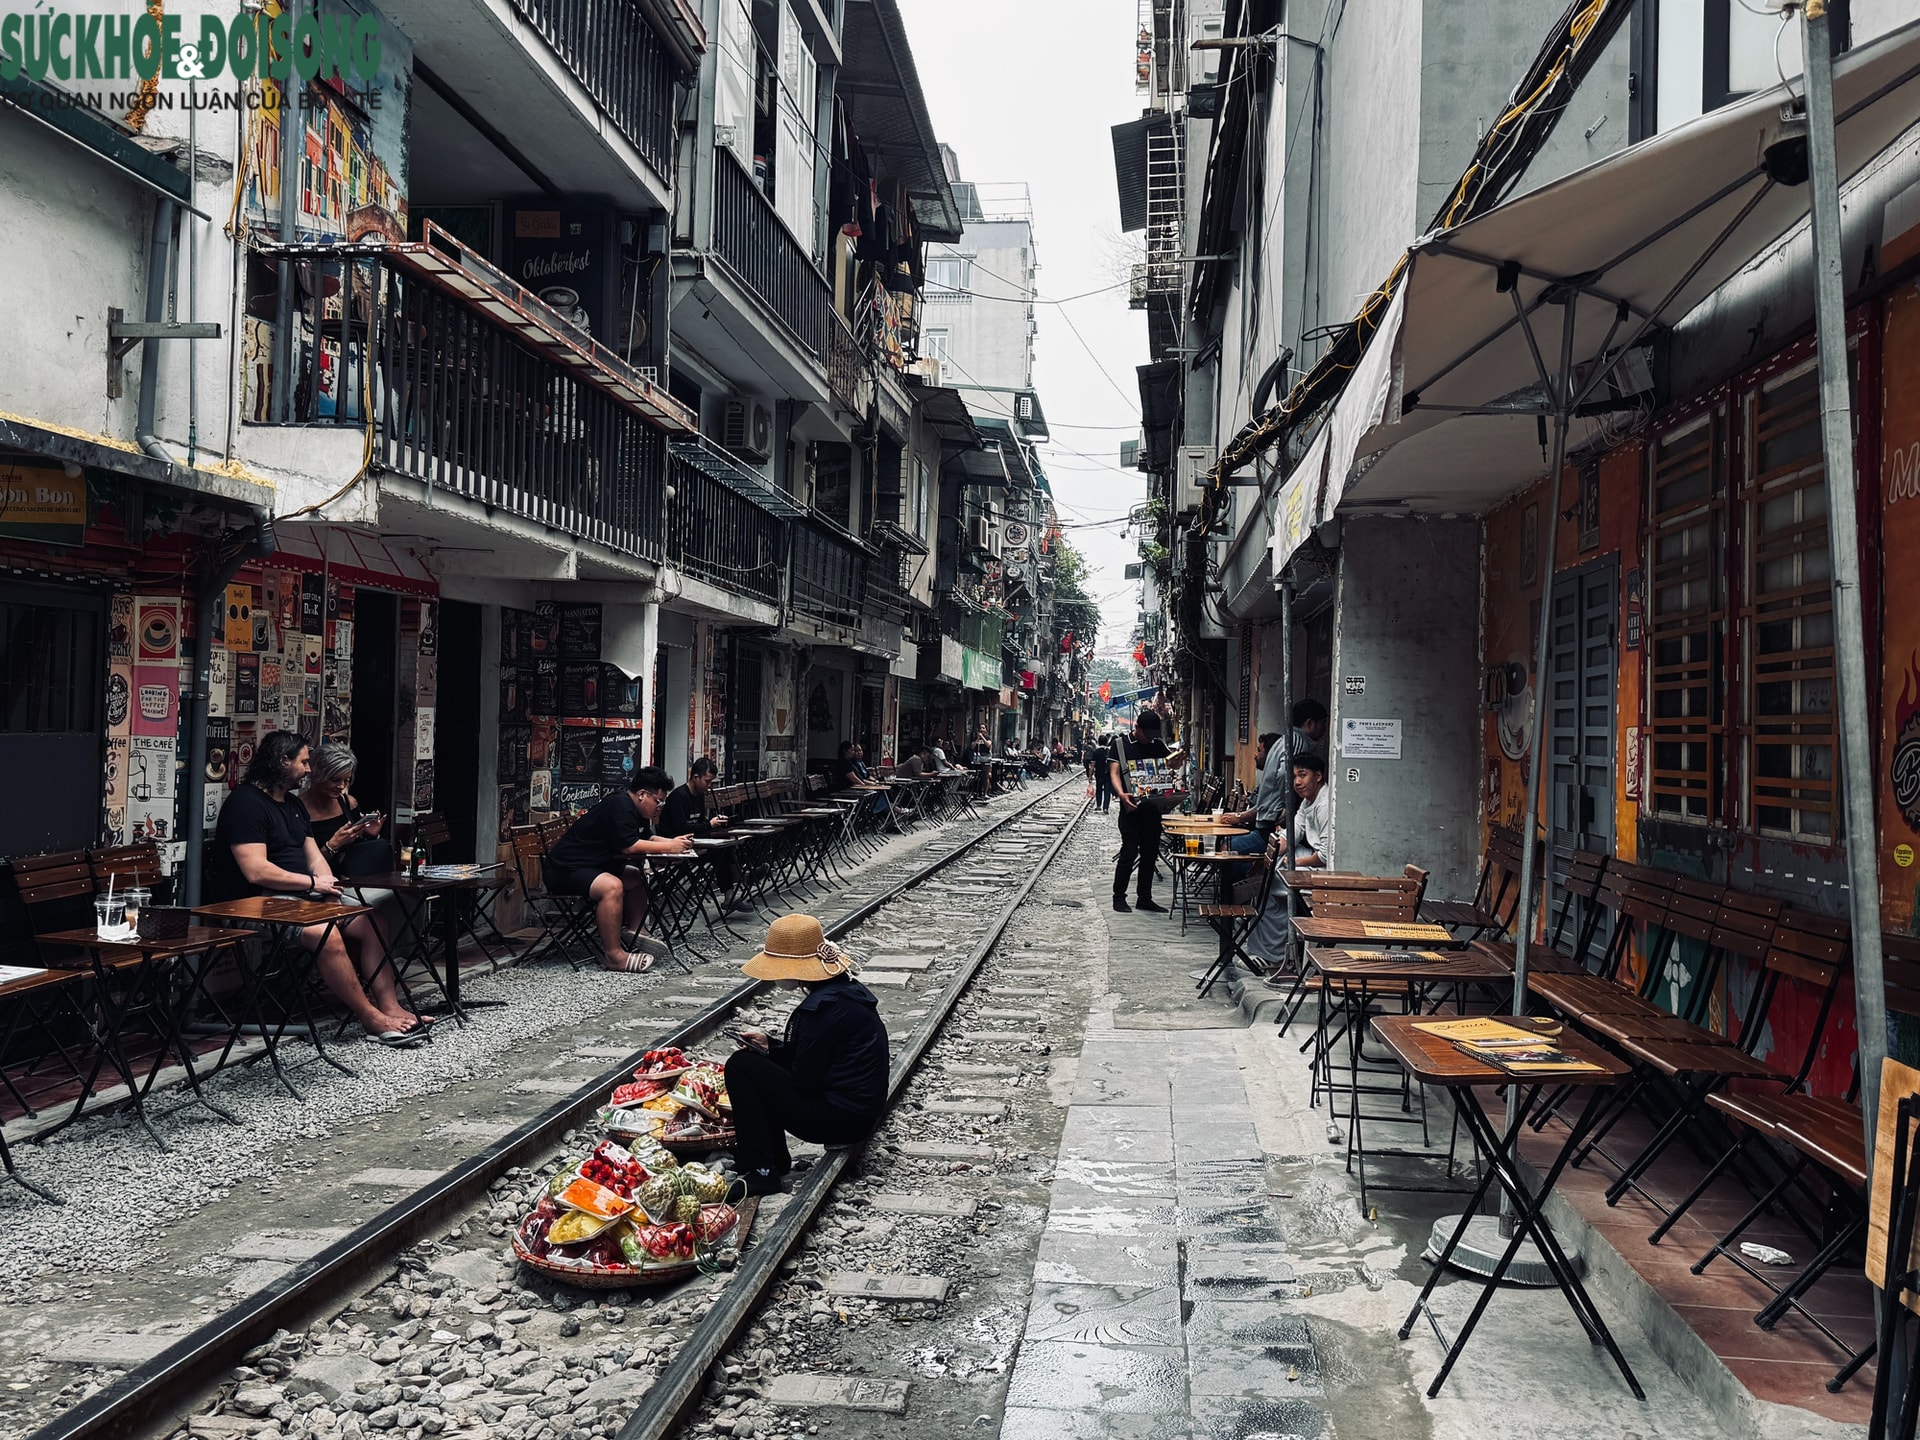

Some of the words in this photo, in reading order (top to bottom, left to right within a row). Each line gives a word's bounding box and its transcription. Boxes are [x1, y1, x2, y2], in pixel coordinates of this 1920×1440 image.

[523, 249, 590, 280] Oktoberfest
[35, 487, 76, 504] Bon
[141, 689, 168, 697] LOOKING
[206, 726, 229, 738] COFFEE
[133, 738, 152, 748] THE
[153, 738, 173, 749] CAFÉ
[561, 785, 599, 803] Cocktails
